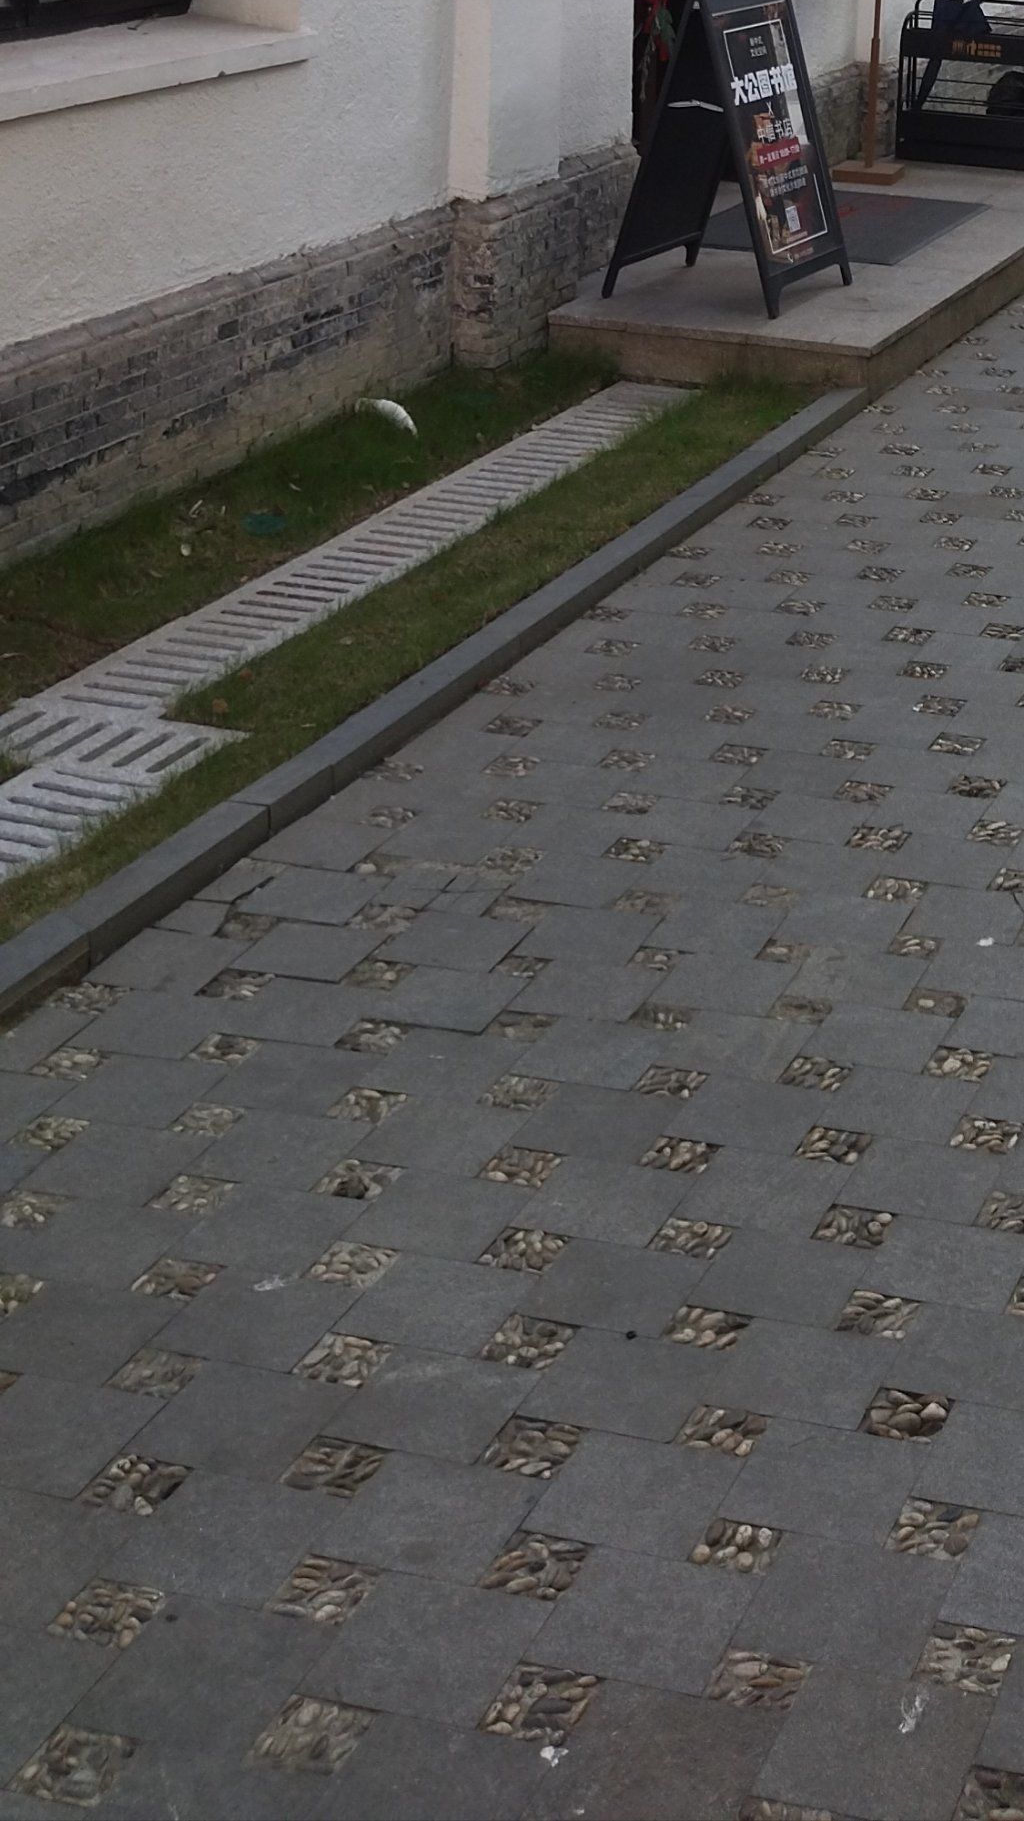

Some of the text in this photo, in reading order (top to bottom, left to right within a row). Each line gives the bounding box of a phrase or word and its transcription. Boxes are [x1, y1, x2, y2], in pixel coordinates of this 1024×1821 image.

[730, 63, 798, 106] 大公图书馆
[756, 118, 795, 142] 中信书店
